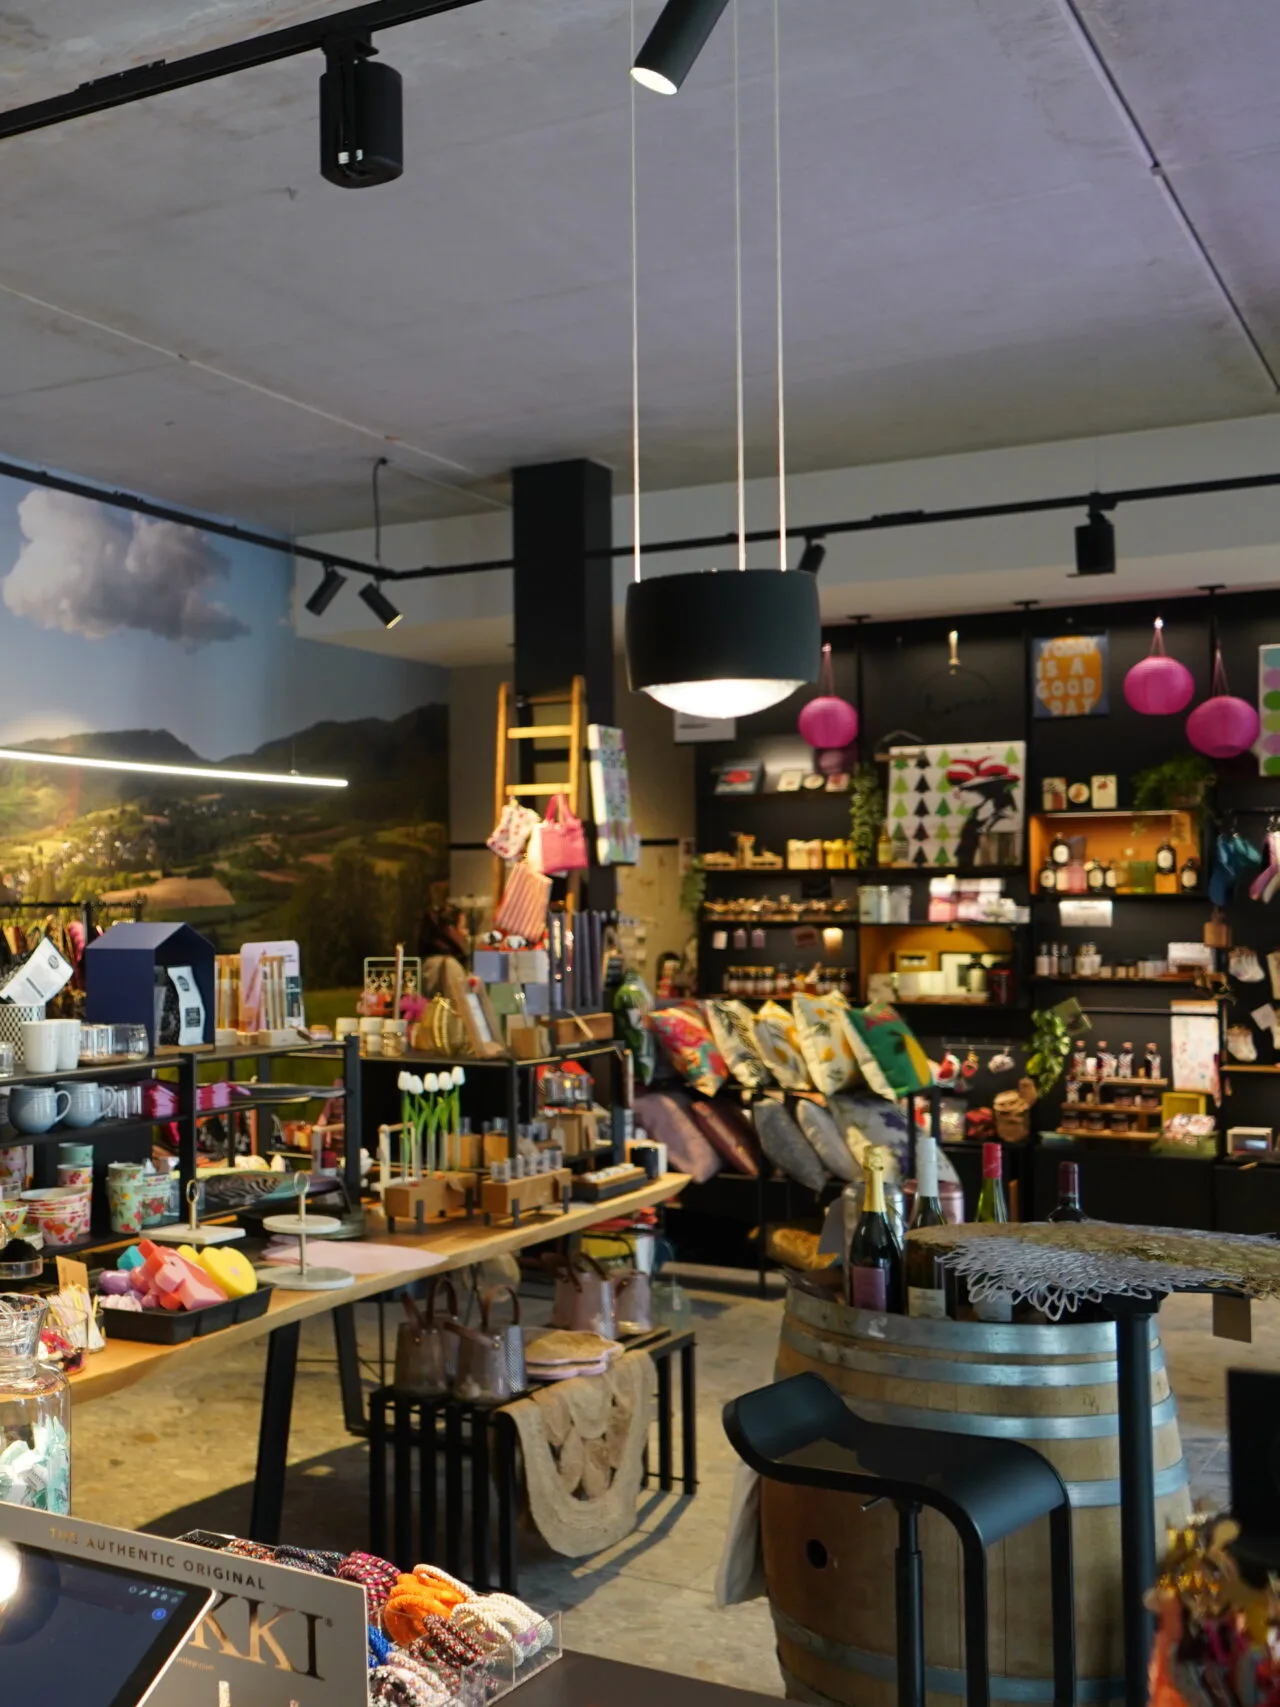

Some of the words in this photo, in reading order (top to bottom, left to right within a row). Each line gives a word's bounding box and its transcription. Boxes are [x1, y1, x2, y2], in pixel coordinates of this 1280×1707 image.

[1036, 660, 1058, 679] IS
[1070, 658, 1085, 676] A
[1035, 677, 1096, 700] GOOD
[86, 1537, 175, 1568] AUTHENTIC
[182, 1559, 266, 1591] ORIGINAL
